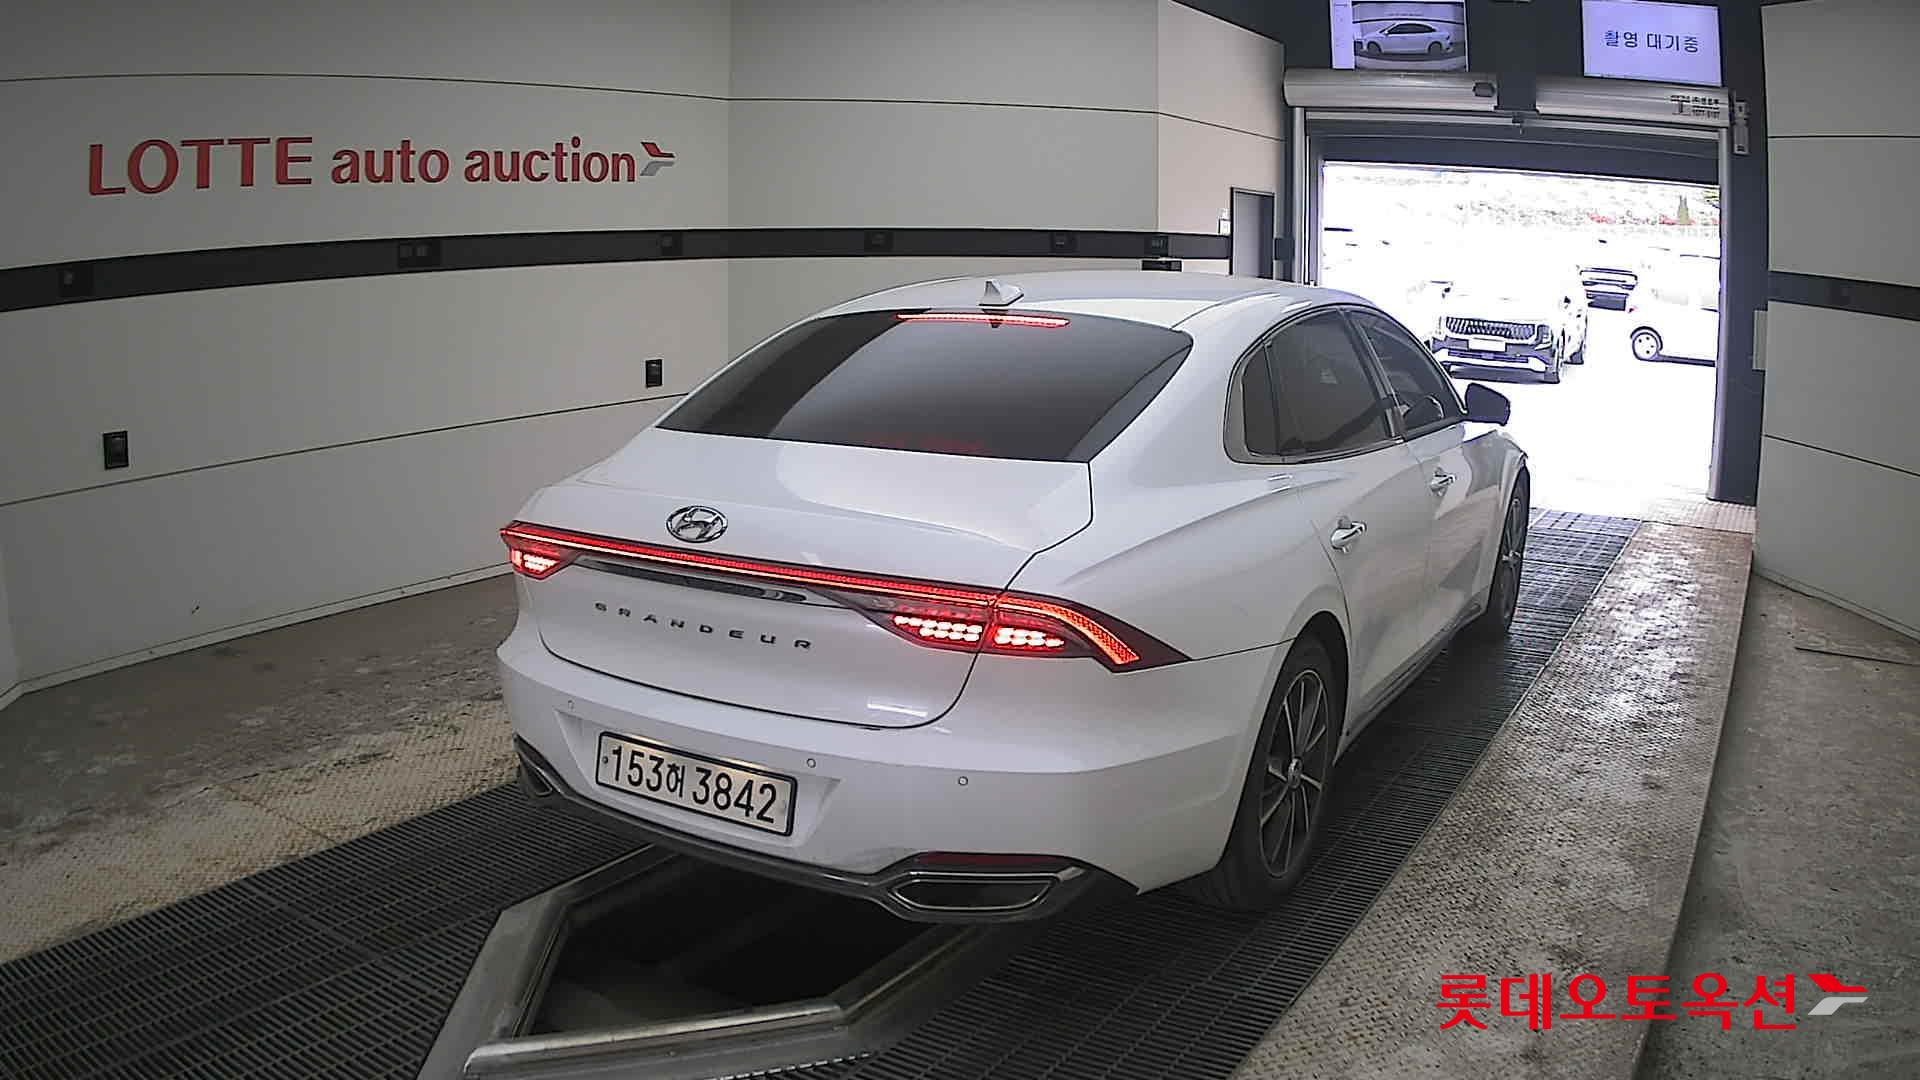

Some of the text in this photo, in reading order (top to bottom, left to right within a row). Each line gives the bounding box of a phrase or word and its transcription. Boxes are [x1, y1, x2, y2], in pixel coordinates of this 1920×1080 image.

[1604, 30, 1698, 53] 촬영 대기중
[88, 136, 635, 195] LOTTE auto auction
[595, 602, 812, 649] GRANDEUR
[611, 745, 778, 824] 153허 3842
